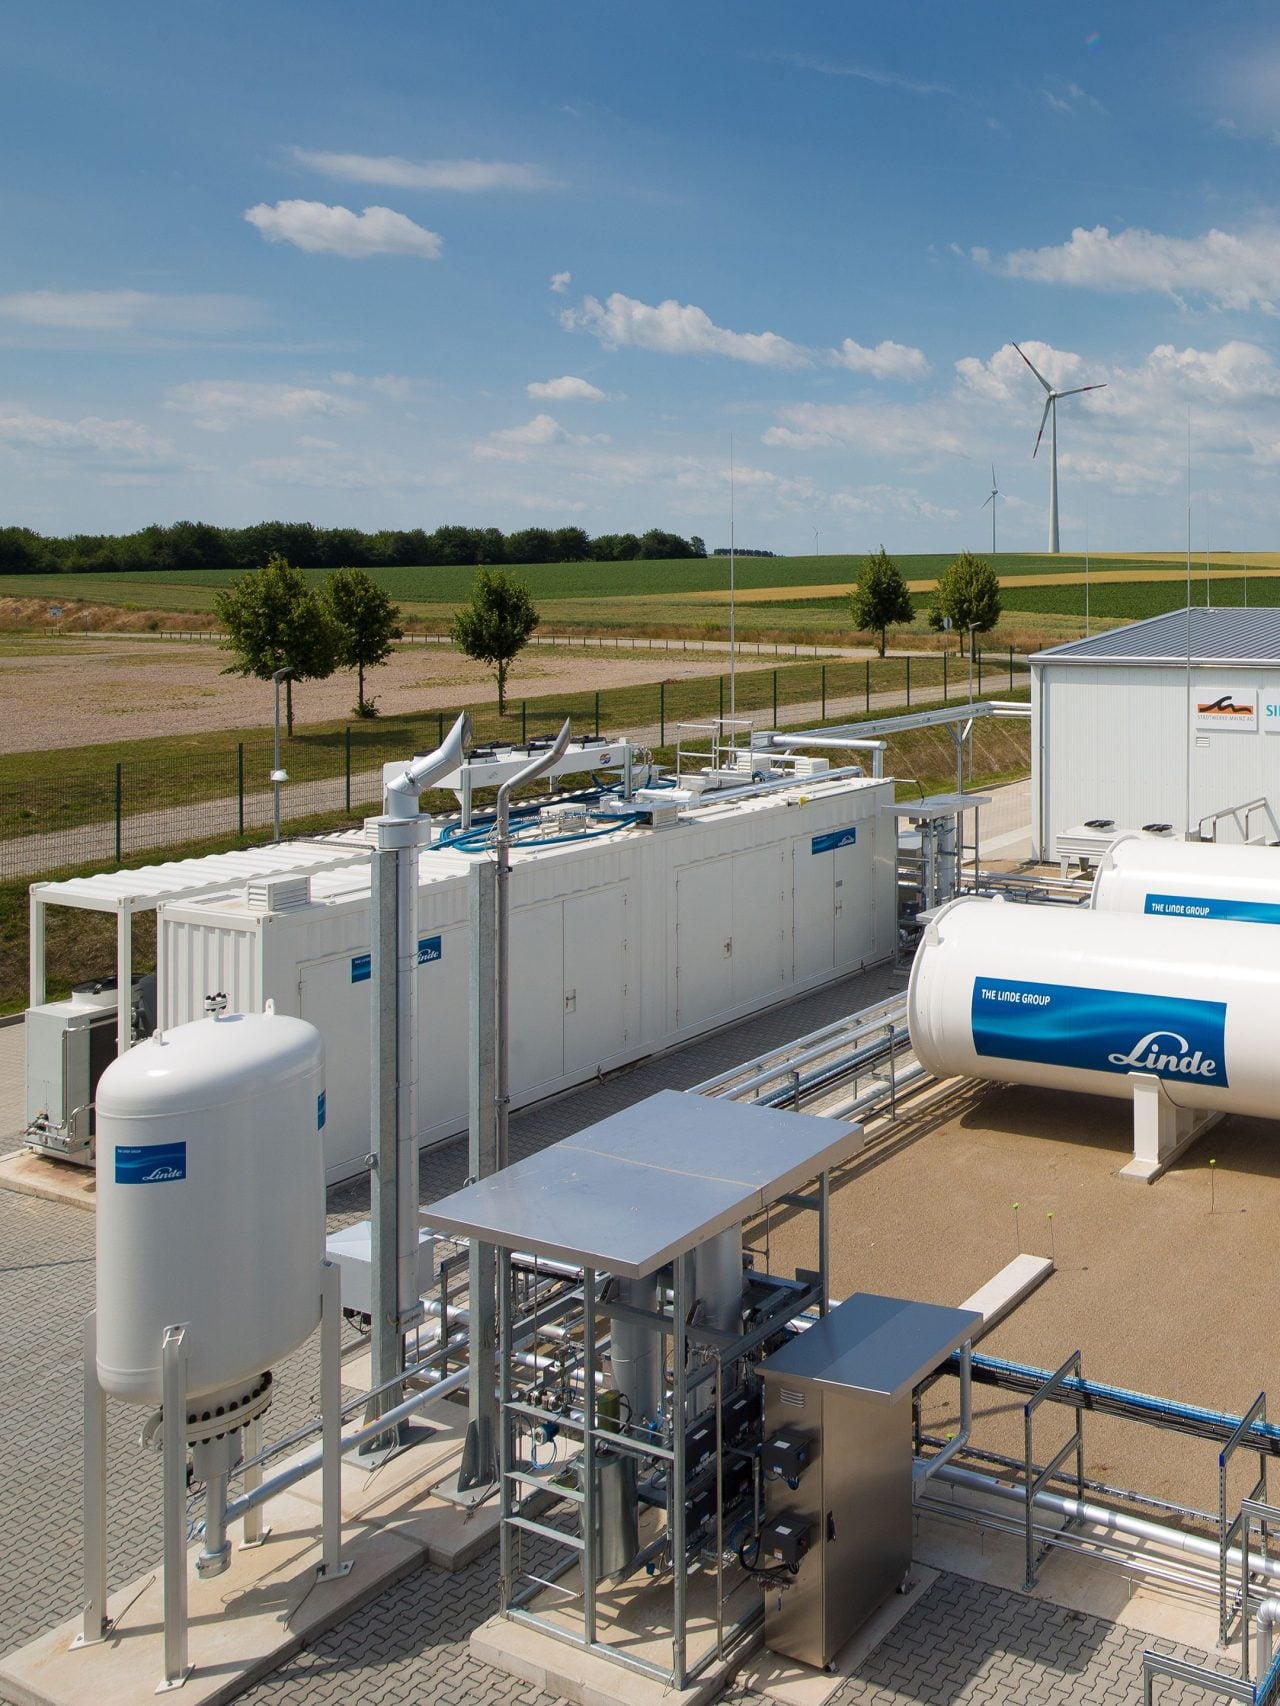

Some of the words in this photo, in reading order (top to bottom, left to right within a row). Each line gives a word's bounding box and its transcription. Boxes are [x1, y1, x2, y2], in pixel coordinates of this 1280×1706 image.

[1151, 903, 1165, 912] THE
[1165, 904, 1185, 914] LINDE
[1185, 905, 1210, 916] GROUP
[981, 988, 996, 1000] THE
[997, 991, 1021, 1003] LINDE
[1021, 993, 1051, 1006] GROUP
[1108, 1031, 1217, 1077] Linde
[142, 1166, 183, 1181] Linde
